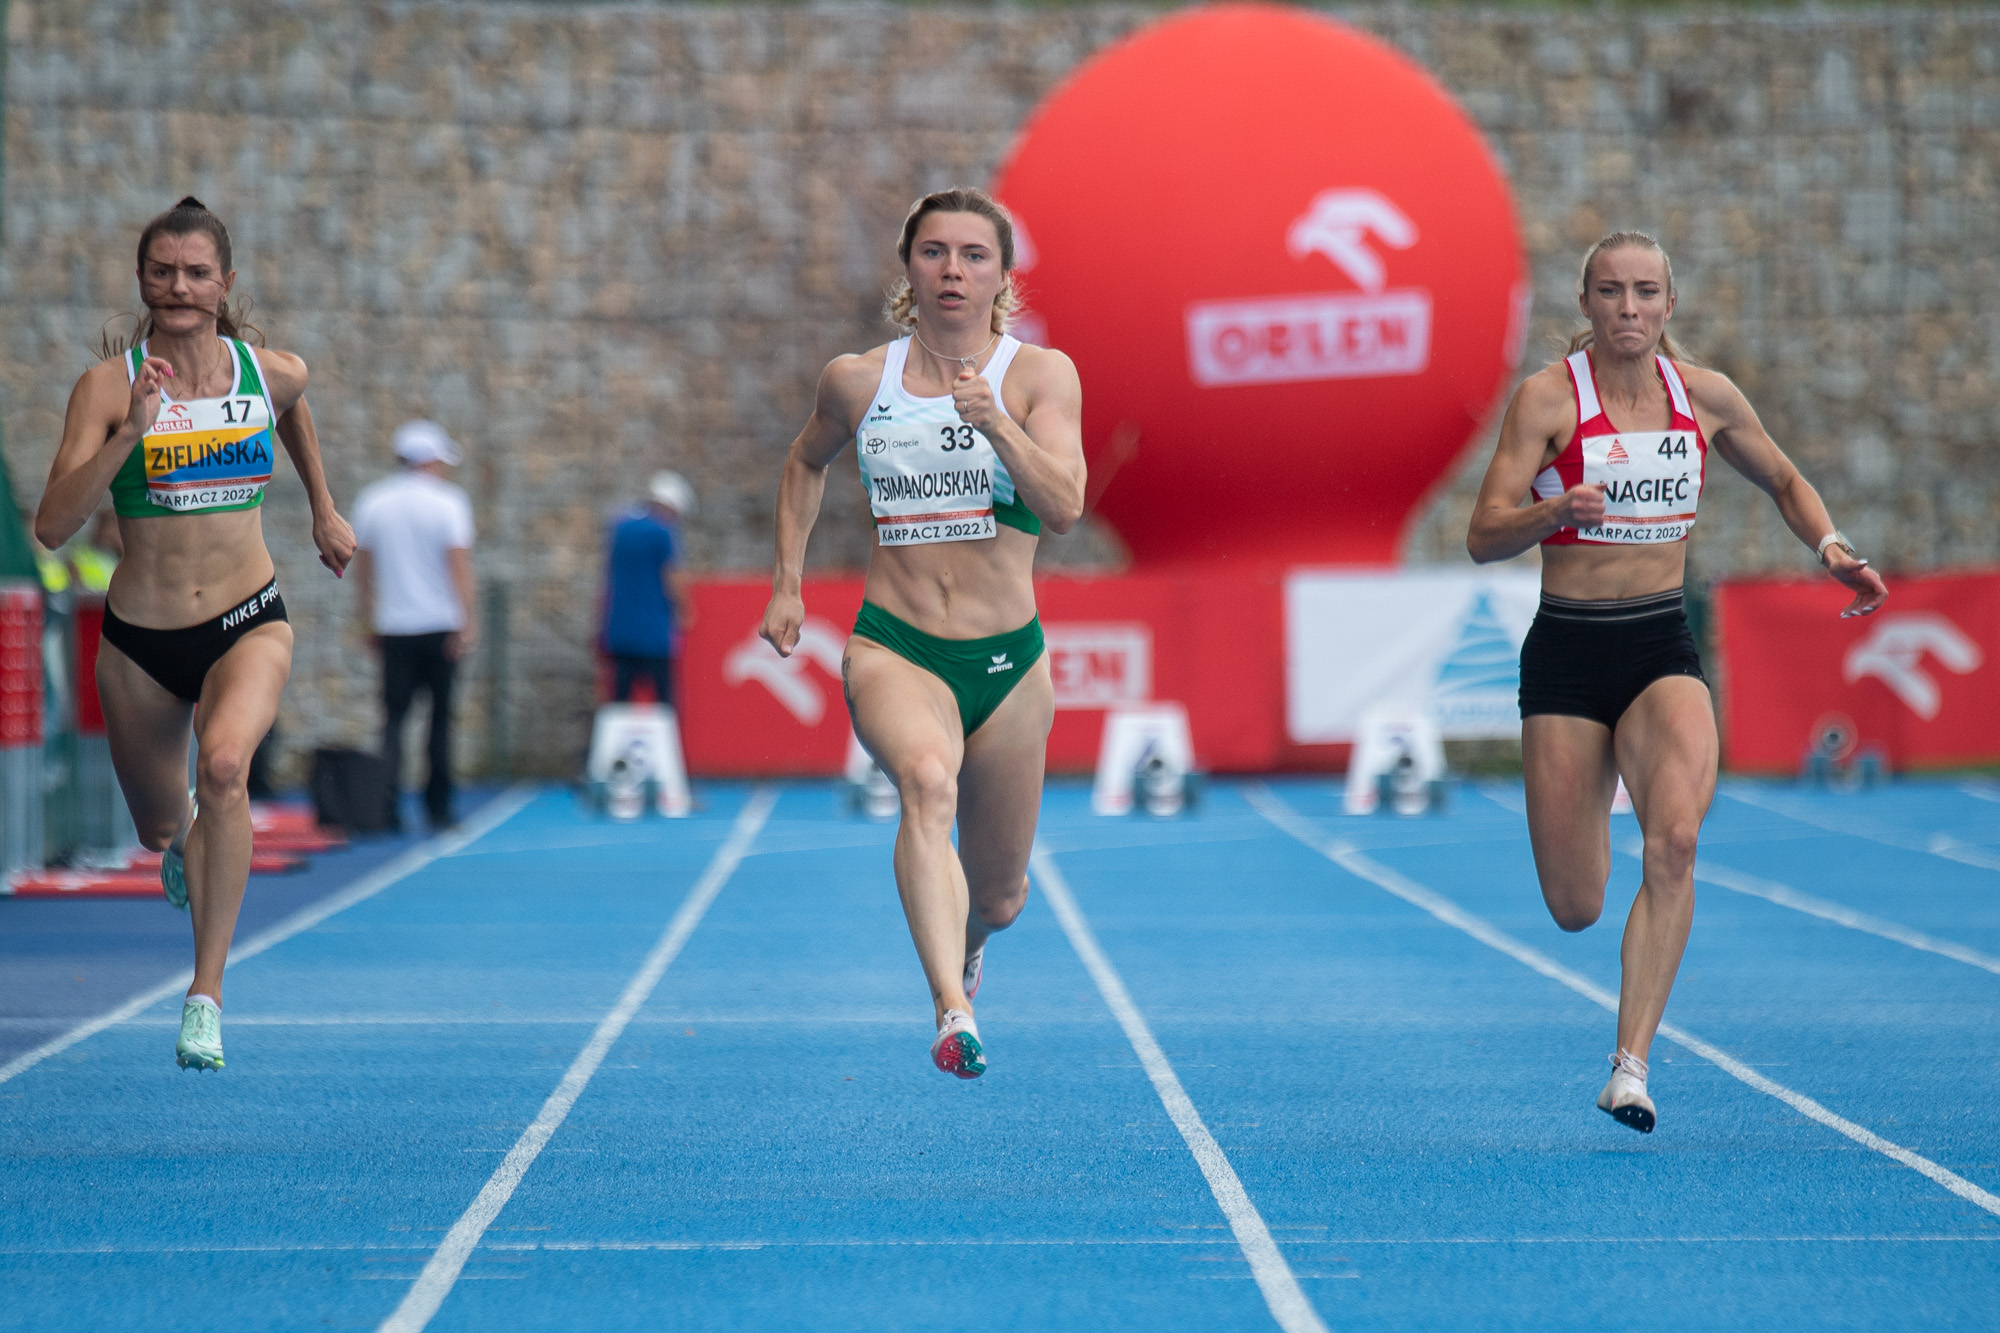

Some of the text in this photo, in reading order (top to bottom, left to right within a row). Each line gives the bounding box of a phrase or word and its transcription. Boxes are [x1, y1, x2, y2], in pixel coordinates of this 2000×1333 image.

[1209, 316, 1411, 370] ORLEN
[220, 400, 251, 424] 17
[870, 414, 893, 422] erima
[155, 421, 191, 432] ORLEN
[940, 425, 975, 452] 33
[151, 437, 268, 471] ZIELIŃSKA
[892, 440, 919, 449] Okęcie
[1657, 436, 1688, 460] 44
[873, 468, 991, 502] TSIMANOUSKAYA
[1602, 472, 1689, 507] NAGIĘĆ
[154, 488, 254, 507] KARPACZ 2022
[882, 523, 980, 542] KARPACZ 2022
[1585, 526, 1682, 540] KARPACZ 2022
[222, 582, 279, 630] NIKE PRO
[987, 662, 1013, 674] erima
